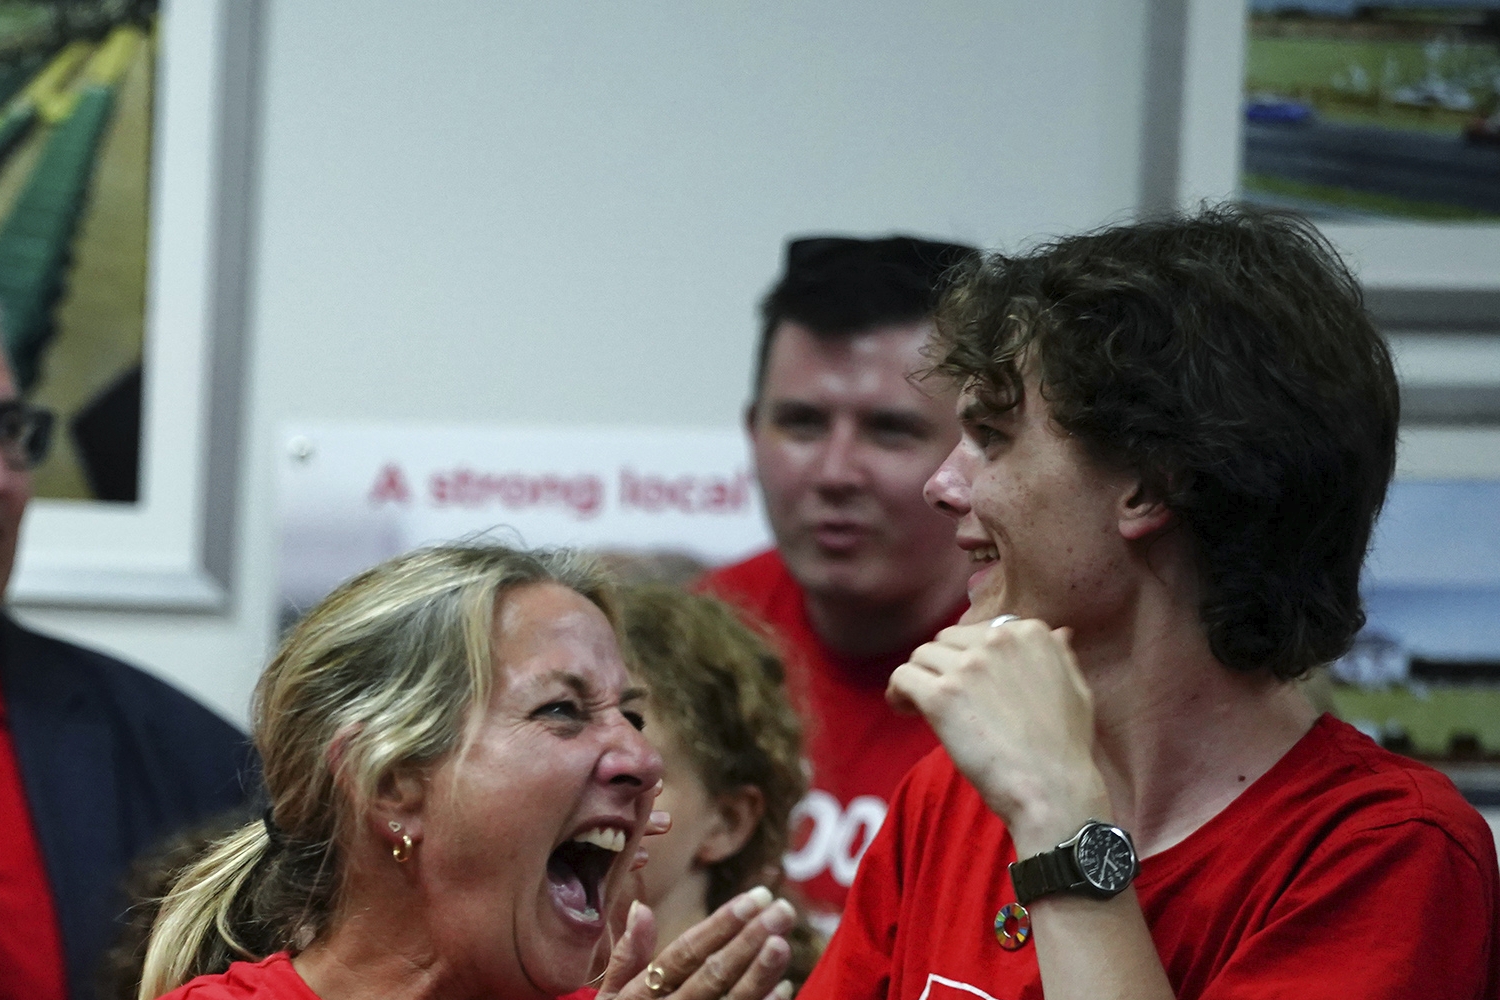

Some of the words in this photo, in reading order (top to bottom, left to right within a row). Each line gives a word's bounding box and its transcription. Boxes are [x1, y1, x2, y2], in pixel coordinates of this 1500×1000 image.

[368, 461, 414, 510] A
[427, 466, 604, 520] strong
[619, 465, 754, 514] local
